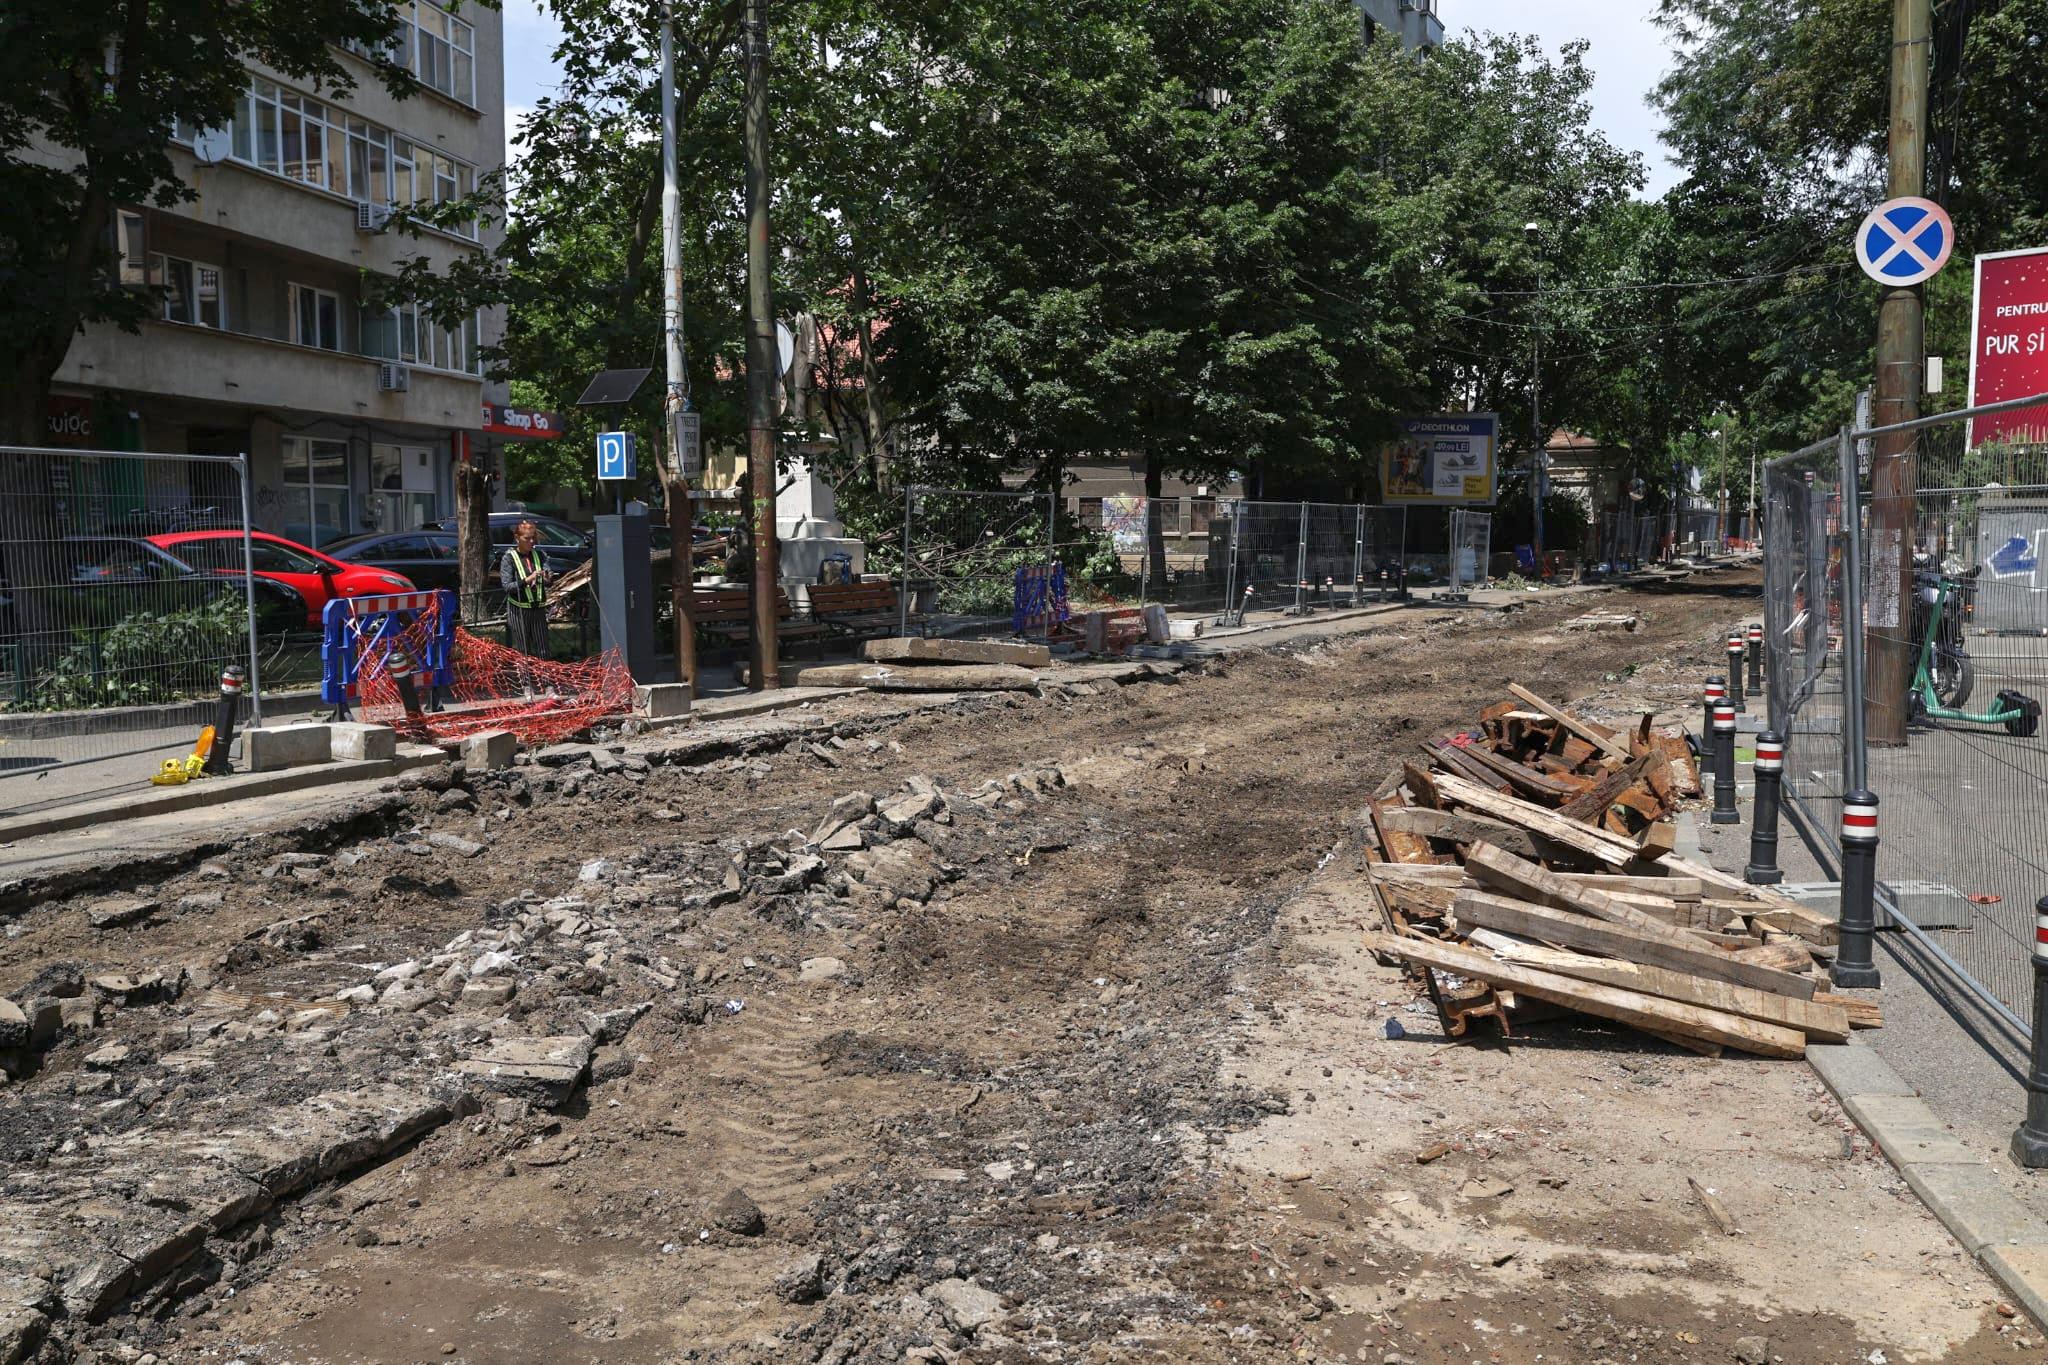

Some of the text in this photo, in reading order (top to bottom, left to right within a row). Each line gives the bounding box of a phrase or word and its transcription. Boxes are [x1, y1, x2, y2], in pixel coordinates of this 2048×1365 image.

[1996, 302, 2048, 317] PENTRU
[1986, 334, 2019, 356] PUR
[504, 409, 549, 430] Shop Go
[1421, 424, 1470, 432] DECATHLON
[603, 438, 620, 473] P
